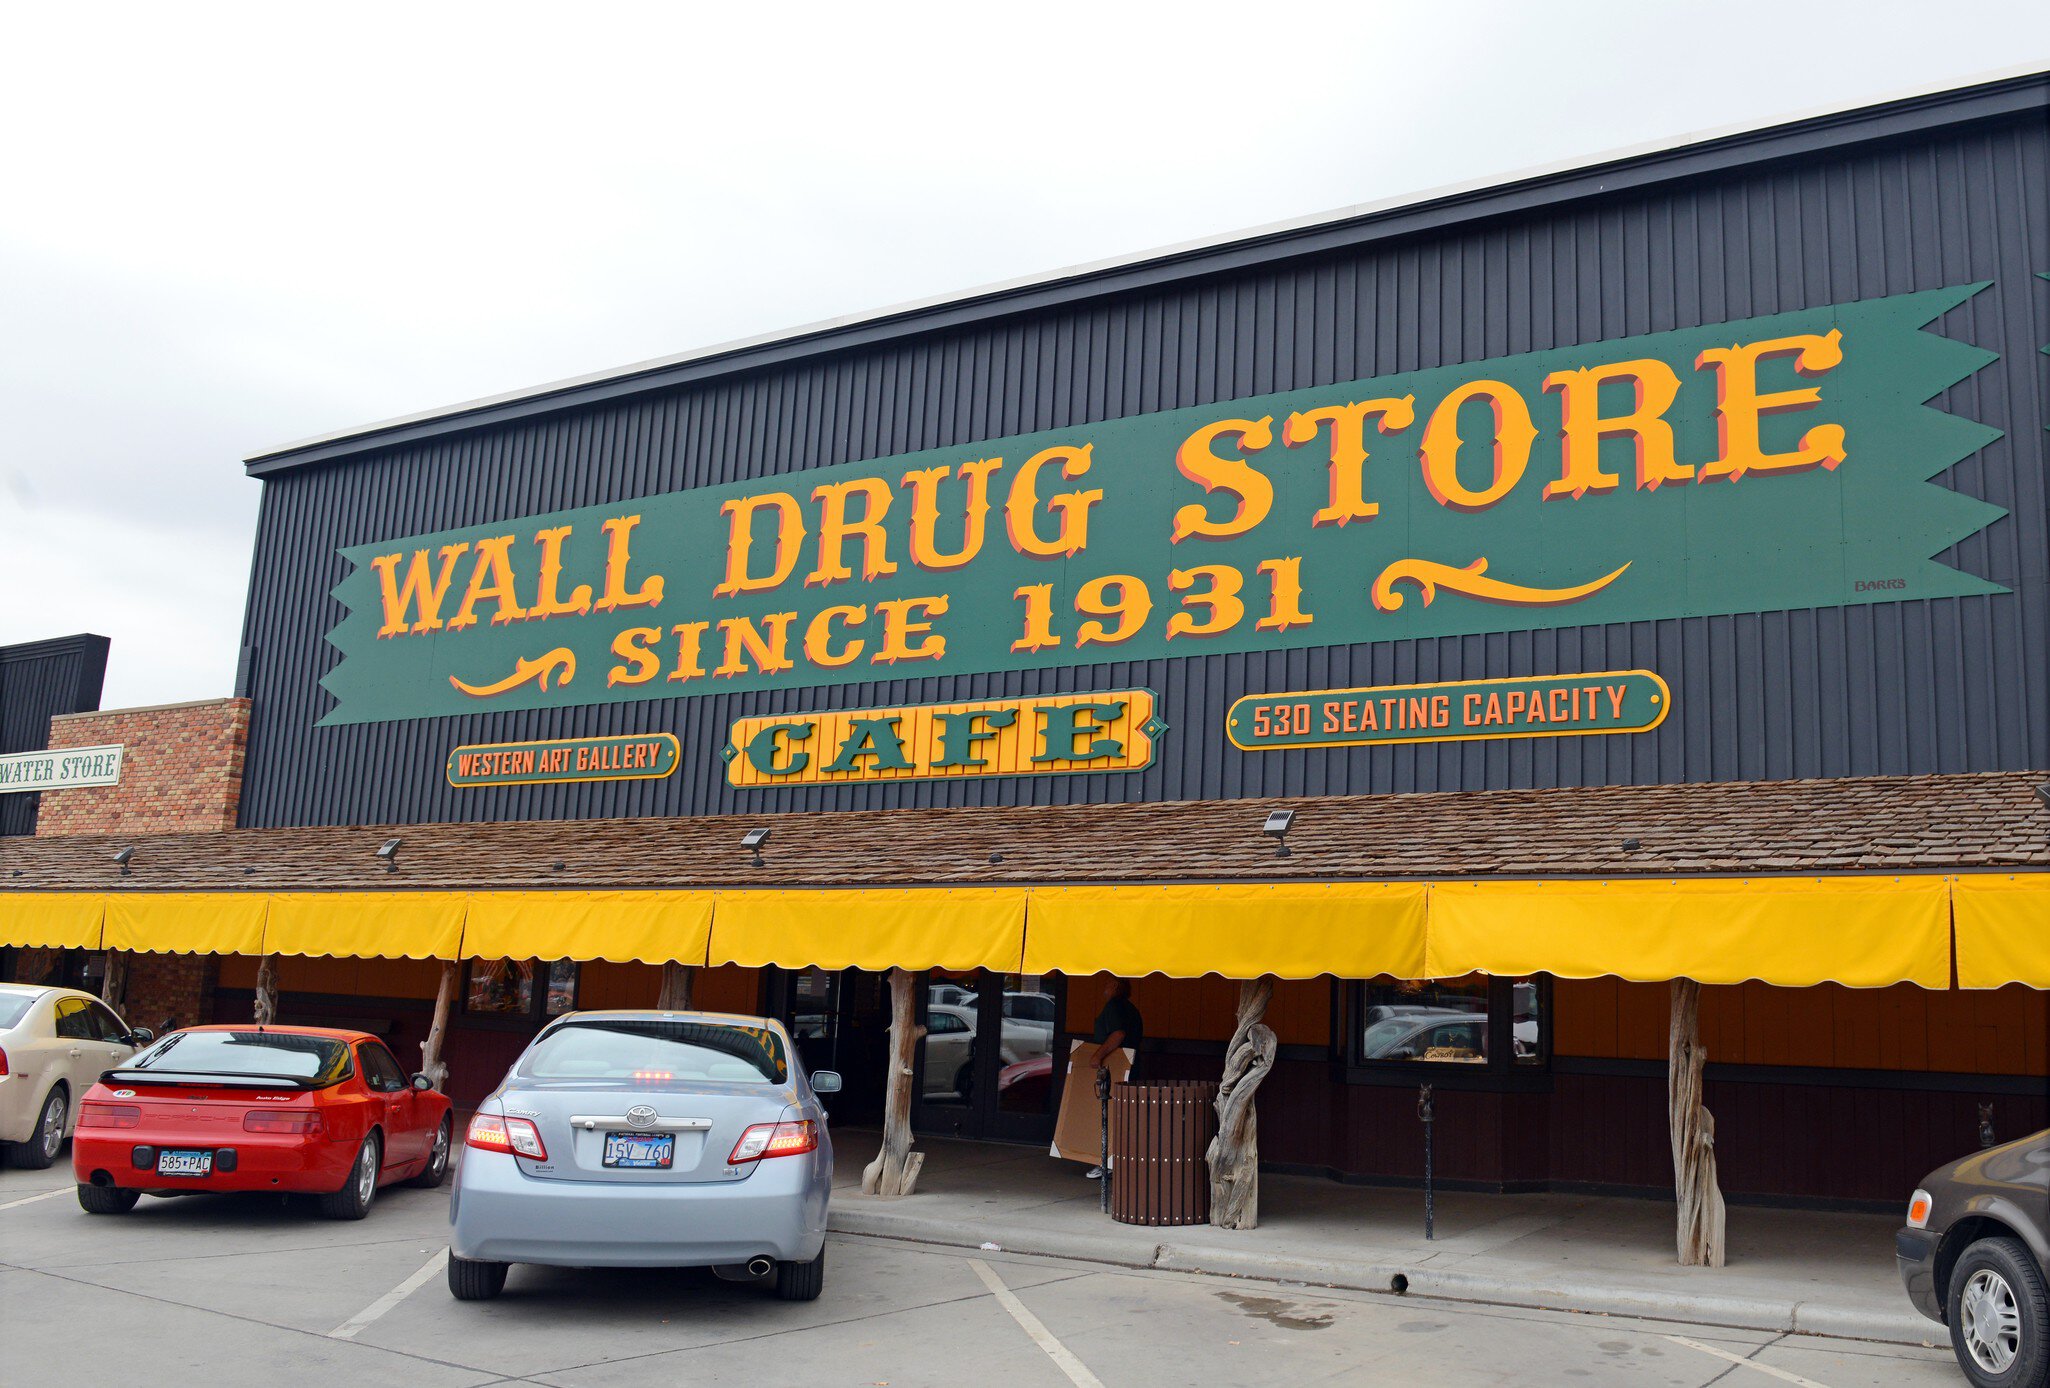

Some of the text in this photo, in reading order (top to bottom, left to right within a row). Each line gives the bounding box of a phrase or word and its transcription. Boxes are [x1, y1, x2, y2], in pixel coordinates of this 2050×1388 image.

[371, 328, 1847, 639] WALL DRUG STORE
[607, 556, 1313, 690] SINCE 1931
[1254, 685, 1627, 737] 530 SEATING CAPACITY
[458, 742, 661, 777] WESTERN ART GALLERY
[743, 701, 1129, 775] CAFE
[0, 754, 116, 784] WATER STORE
[161, 1156, 210, 1170] 585 PAC
[644, 1143, 671, 1160] 760
